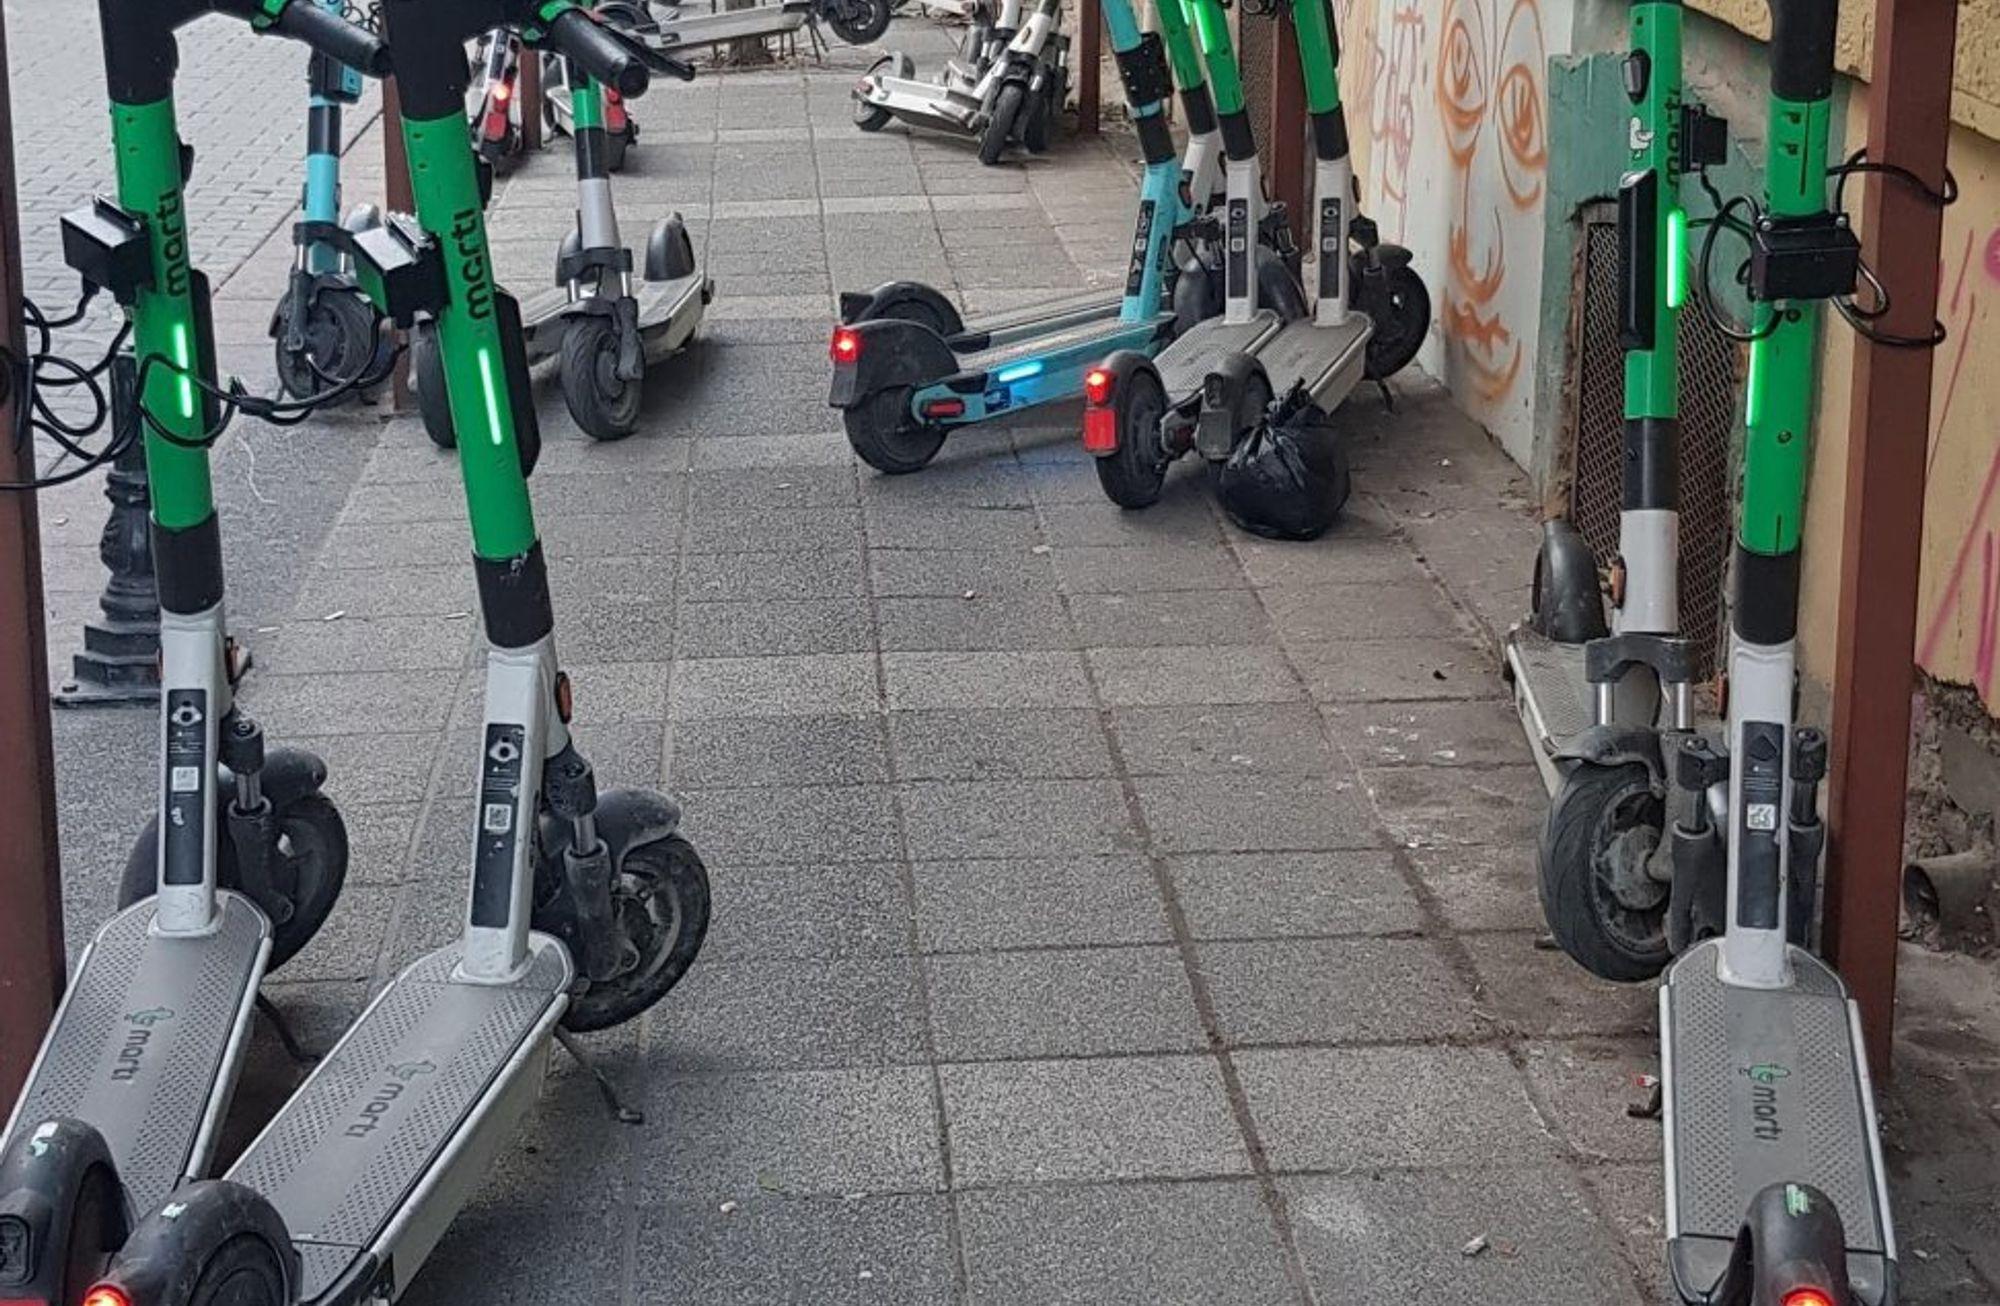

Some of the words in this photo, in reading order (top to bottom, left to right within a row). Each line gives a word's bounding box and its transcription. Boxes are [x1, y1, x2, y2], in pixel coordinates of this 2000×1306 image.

[156, 187, 187, 297] marti
[451, 208, 491, 320] marti
[111, 1029, 151, 1081] marti
[344, 1082, 404, 1138] marti
[1752, 1084, 1783, 1140] marti
